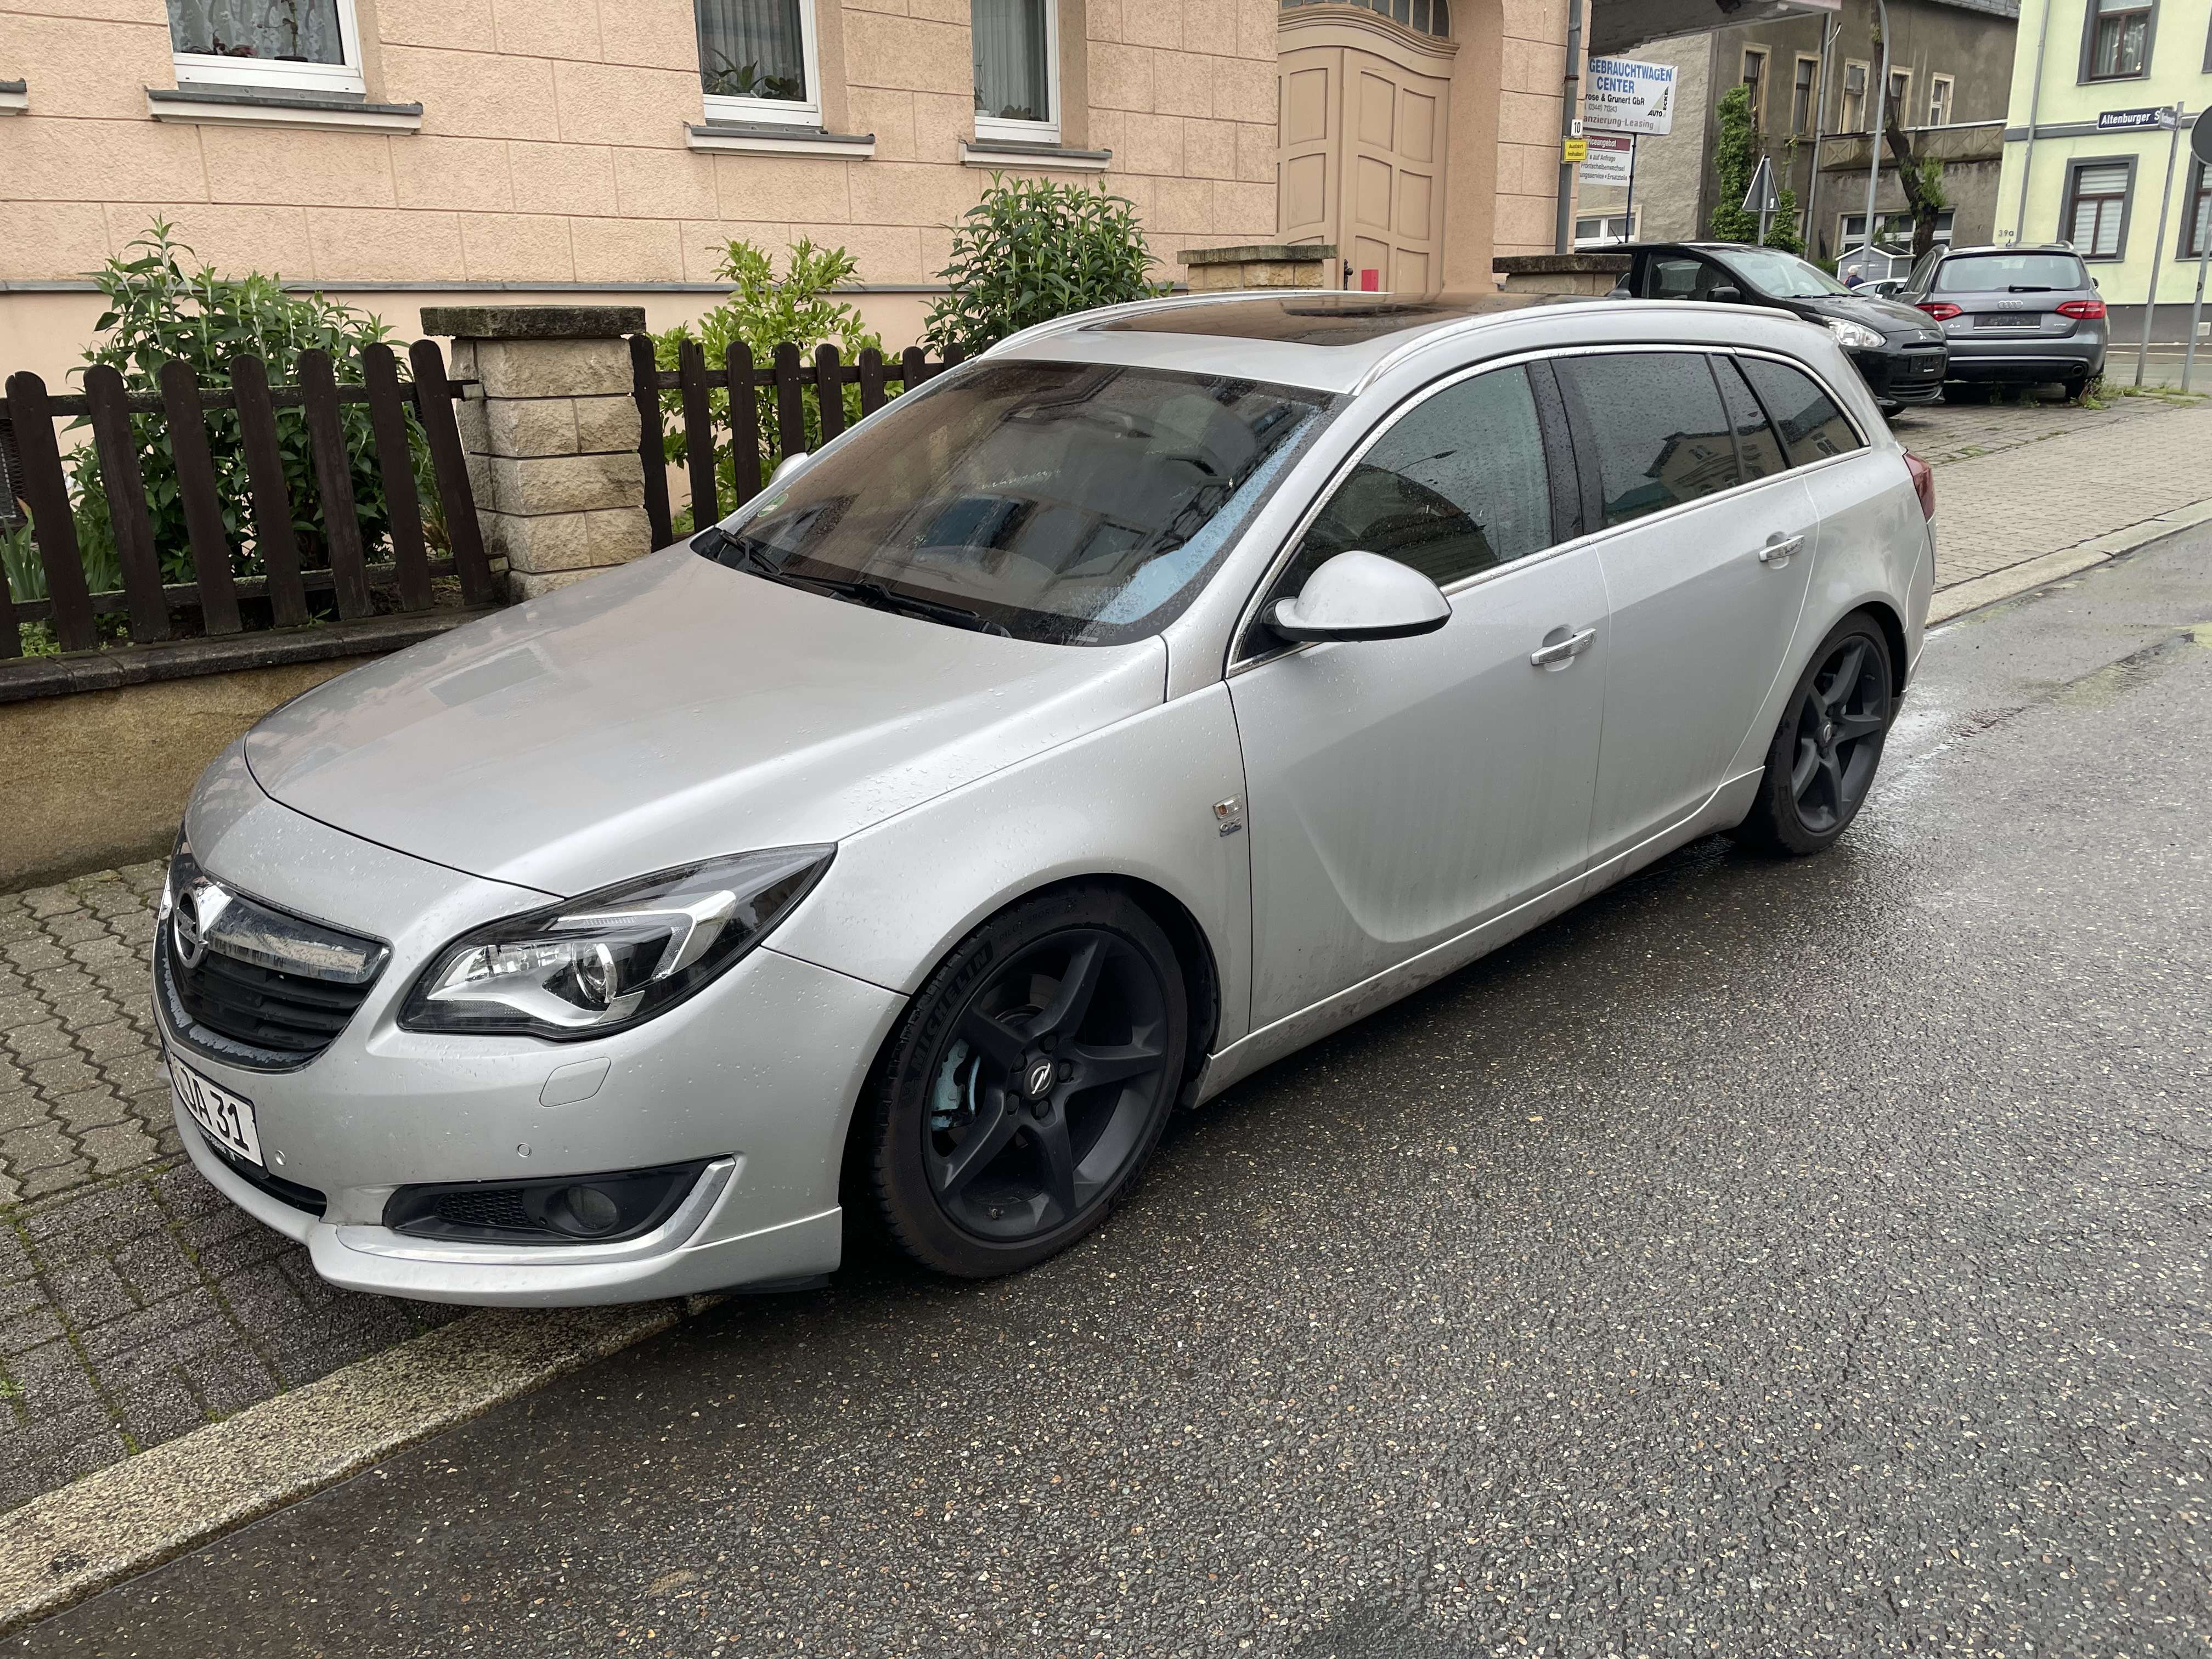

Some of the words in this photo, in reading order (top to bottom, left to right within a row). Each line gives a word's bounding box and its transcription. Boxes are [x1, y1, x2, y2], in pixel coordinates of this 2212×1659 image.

[1589, 59, 1672, 82] GEBRAUCHTWAGEN
[1596, 76, 1634, 94] CENTER
[1601, 93, 1605, 101] &
[1632, 96, 1645, 106] GbR
[1574, 122, 1581, 133] 10
[2101, 112, 2151, 125] Altenburger
[910, 950, 990, 1071] MICHELIN
[210, 1090, 250, 1152] 31
